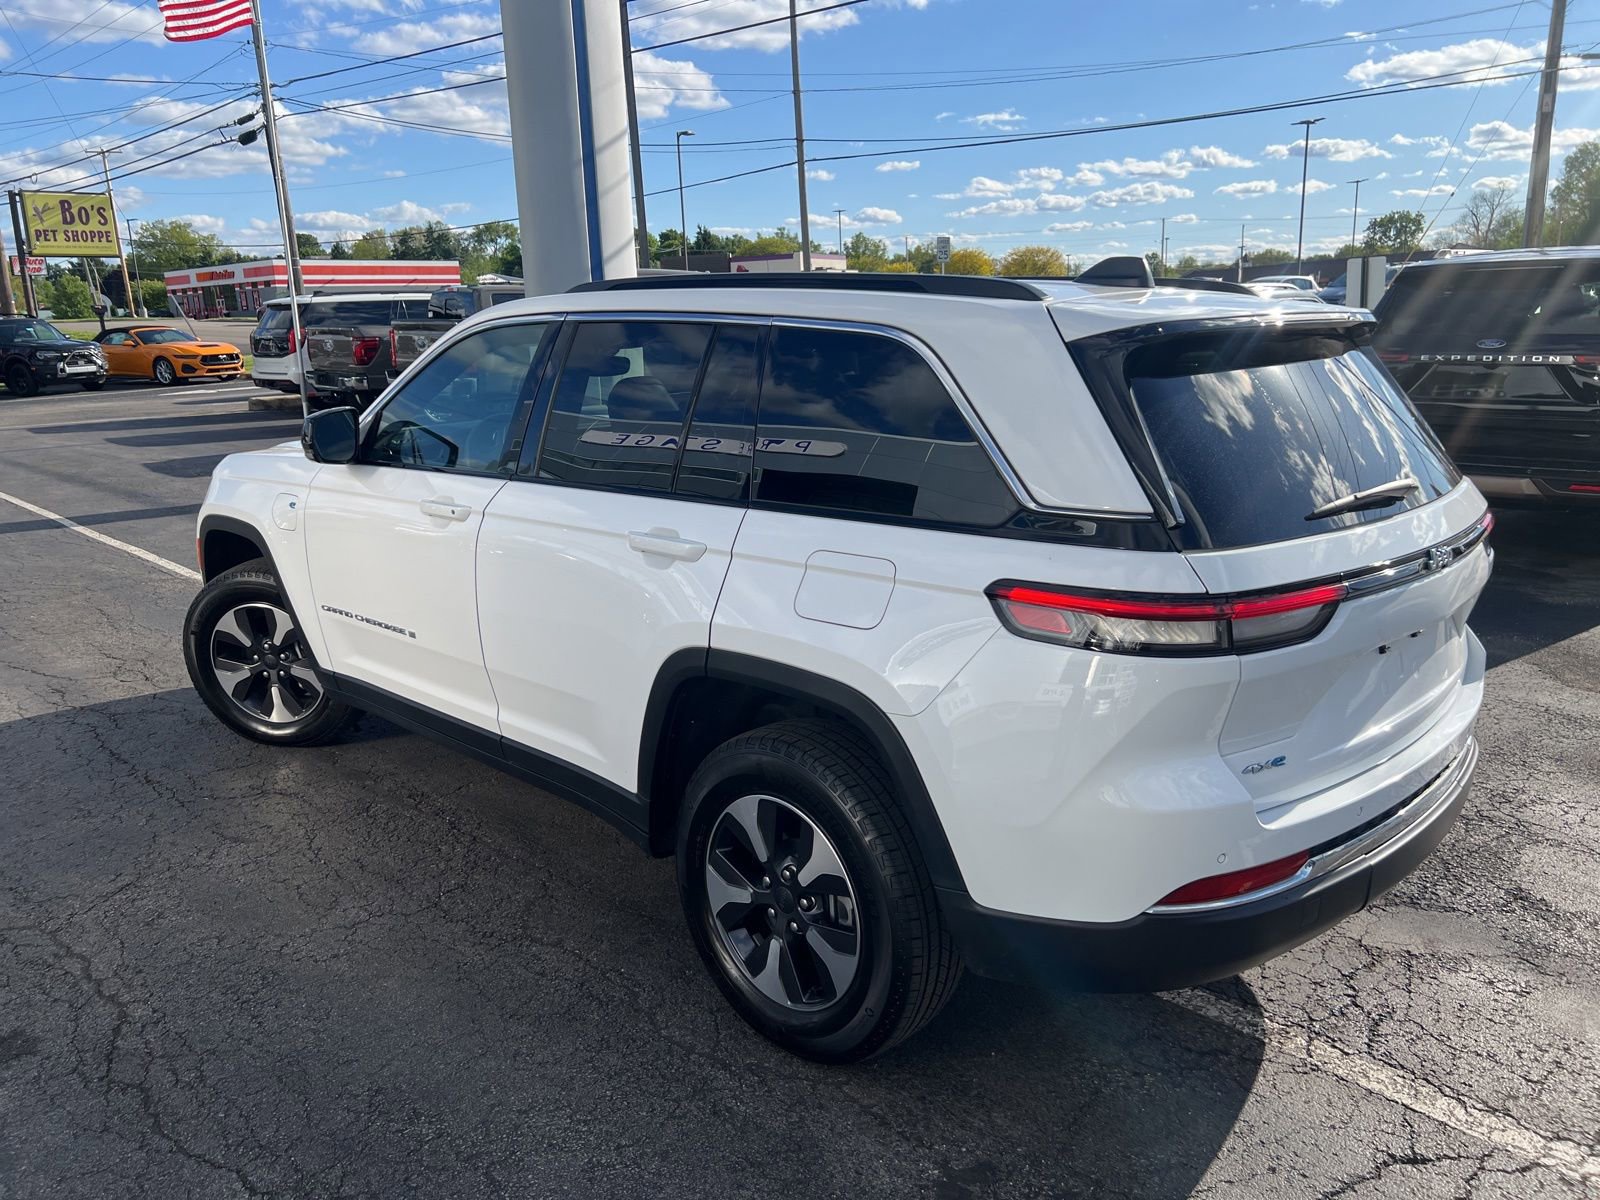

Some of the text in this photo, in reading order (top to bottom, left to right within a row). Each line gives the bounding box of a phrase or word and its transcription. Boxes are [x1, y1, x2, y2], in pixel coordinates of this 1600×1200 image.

[34, 229, 113, 243] PET SHOPPE
[938, 250, 949, 260] 25
[1420, 354, 1561, 362] EXPEDITION
[321, 604, 407, 635] GRAND CHEROKEE
